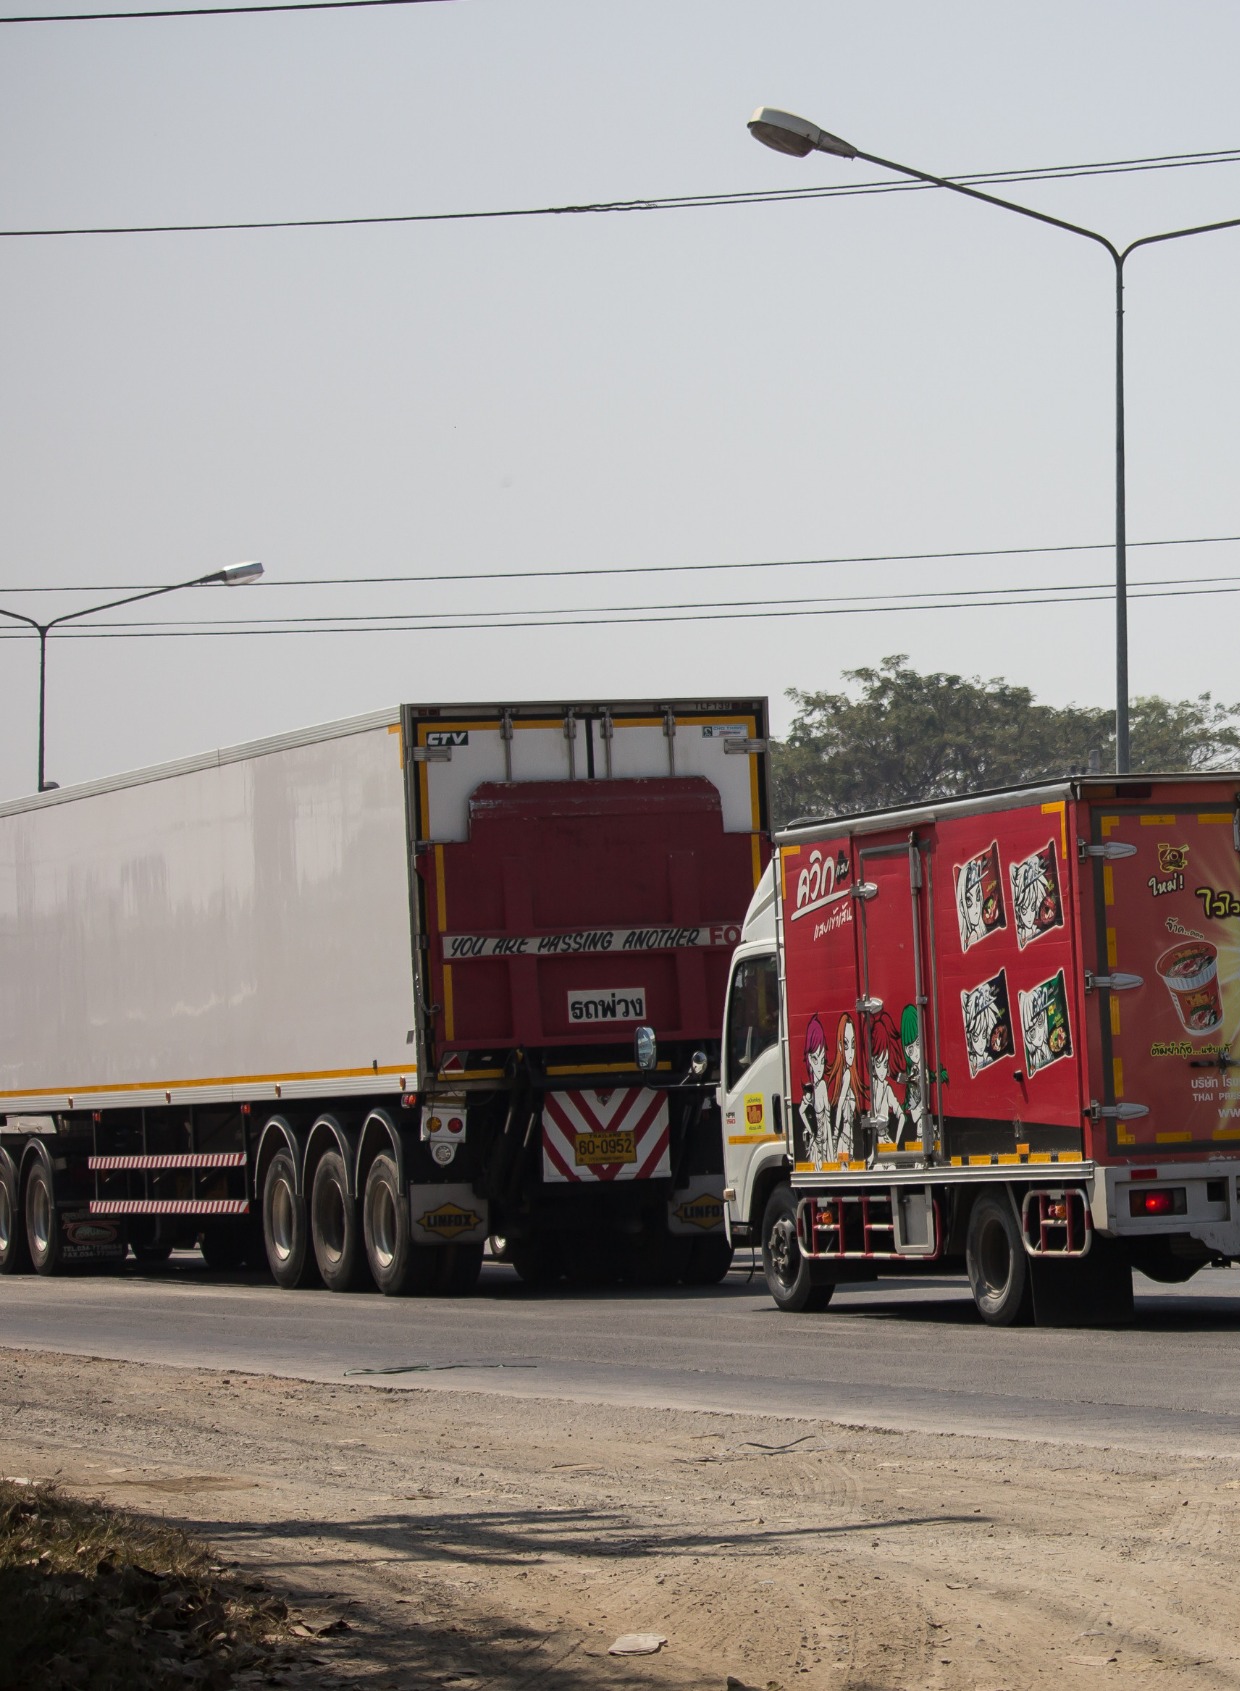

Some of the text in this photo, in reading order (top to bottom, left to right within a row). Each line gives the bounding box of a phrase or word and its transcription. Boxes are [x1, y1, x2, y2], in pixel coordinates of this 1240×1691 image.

[427, 732, 467, 745] CTV
[450, 926, 742, 957] YOU ARE PASSING ANOTHER FO
[570, 992, 643, 1020] รถพ่วง
[1192, 1092, 1214, 1102] THAI
[579, 1138, 632, 1155] 60-0952
[427, 1214, 473, 1228] LINFOX
